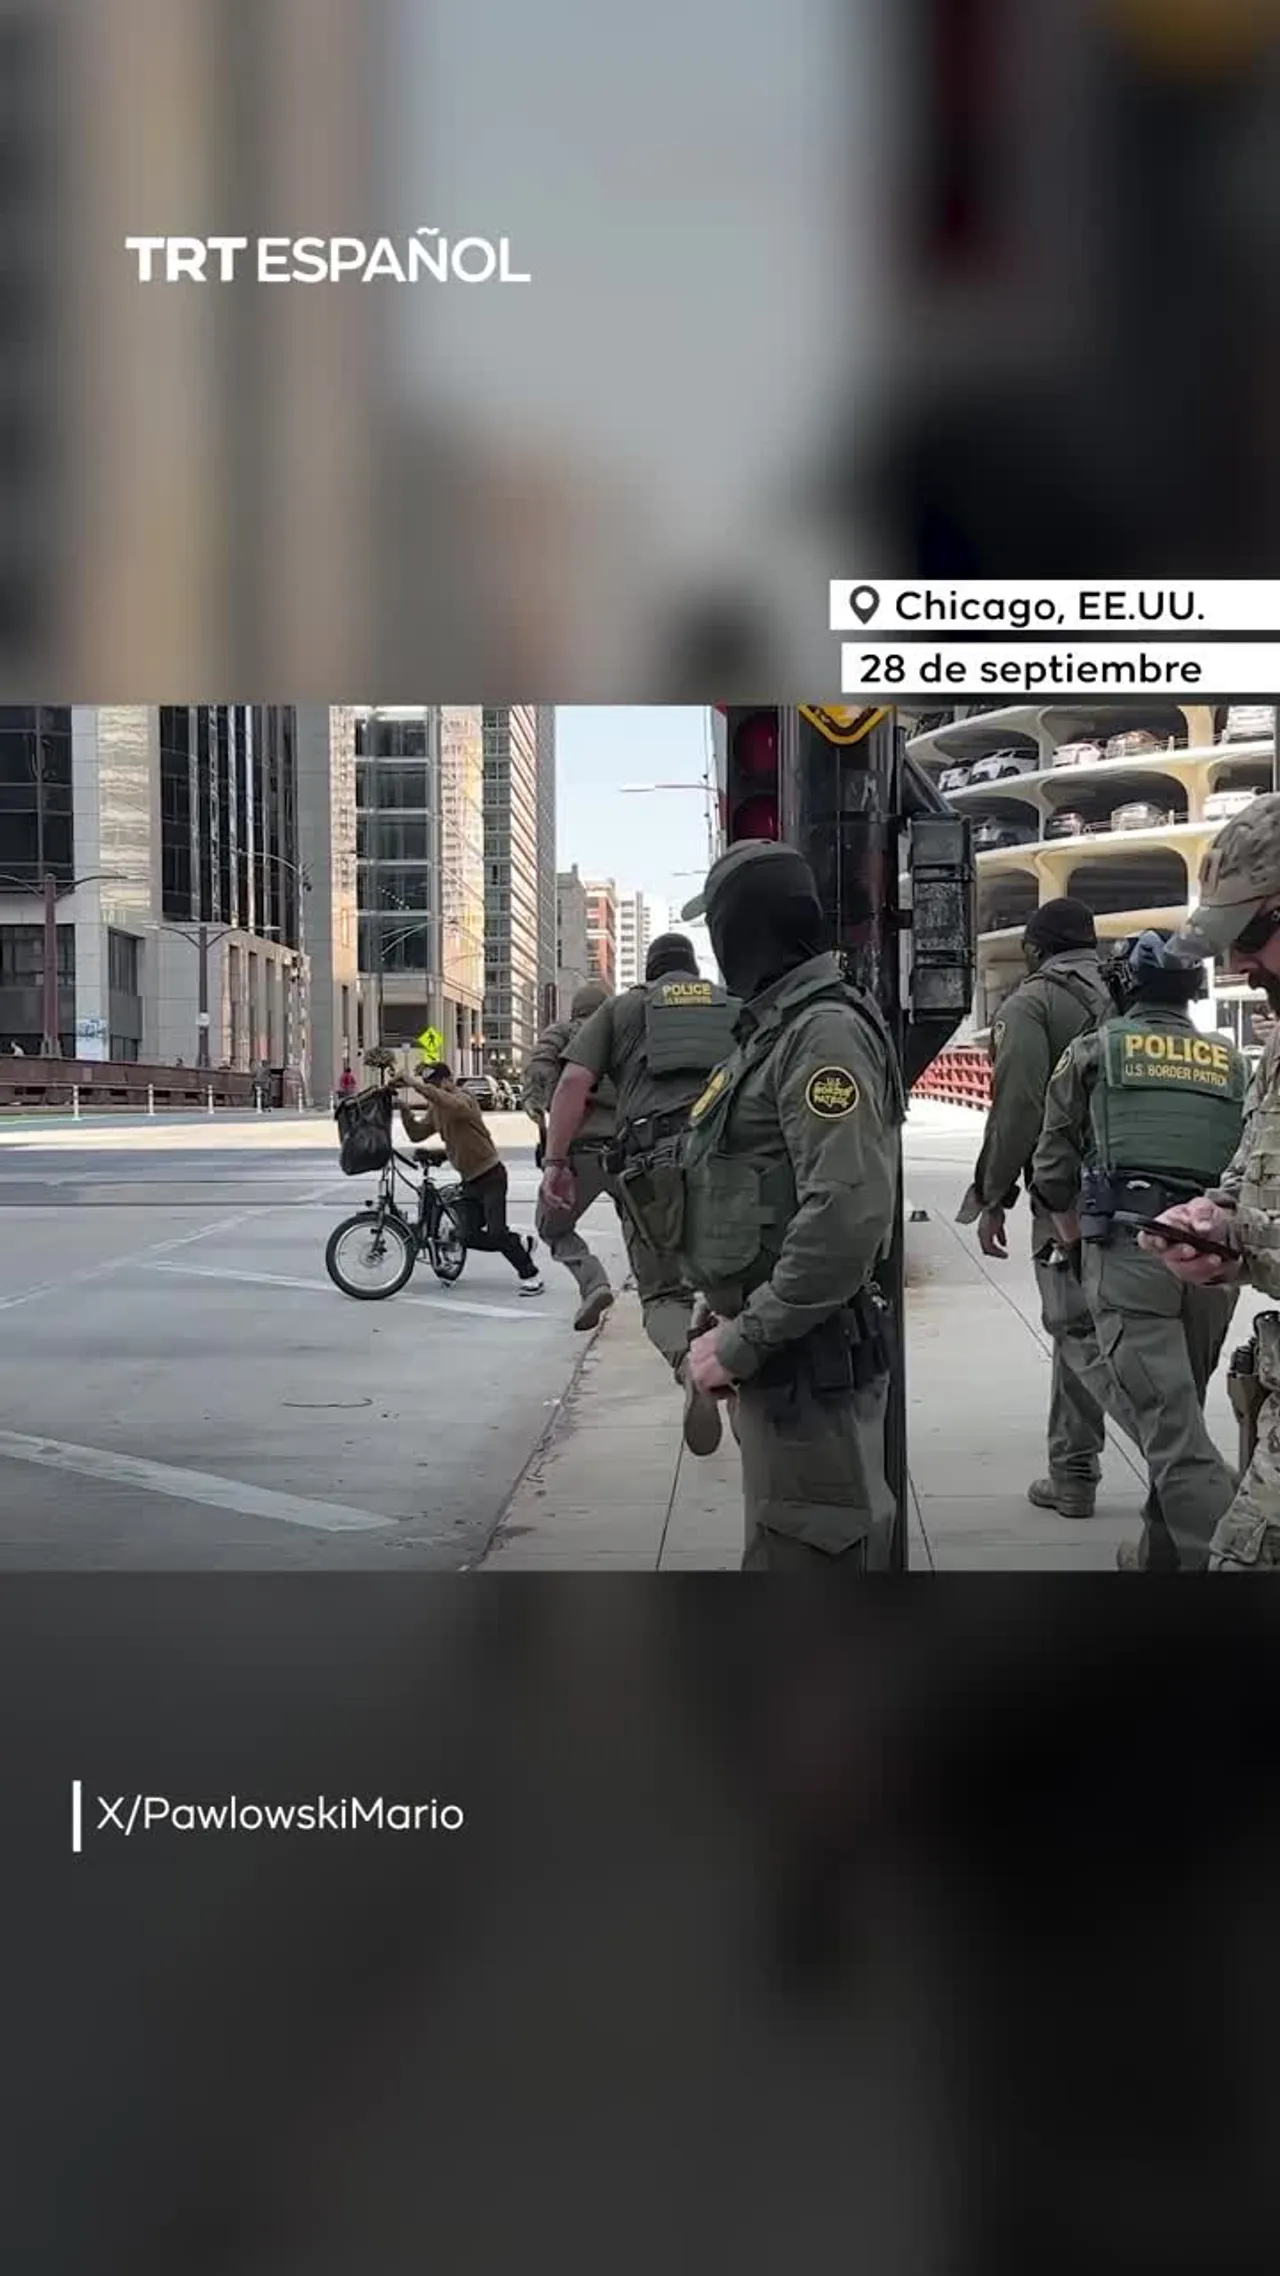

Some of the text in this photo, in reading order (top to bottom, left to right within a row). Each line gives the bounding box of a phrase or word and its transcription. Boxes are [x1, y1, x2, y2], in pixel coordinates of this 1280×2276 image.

[662, 982, 713, 997] POLICE
[1124, 1033, 1230, 1073] POLICE
[1147, 1064, 1192, 1081] BORDER
